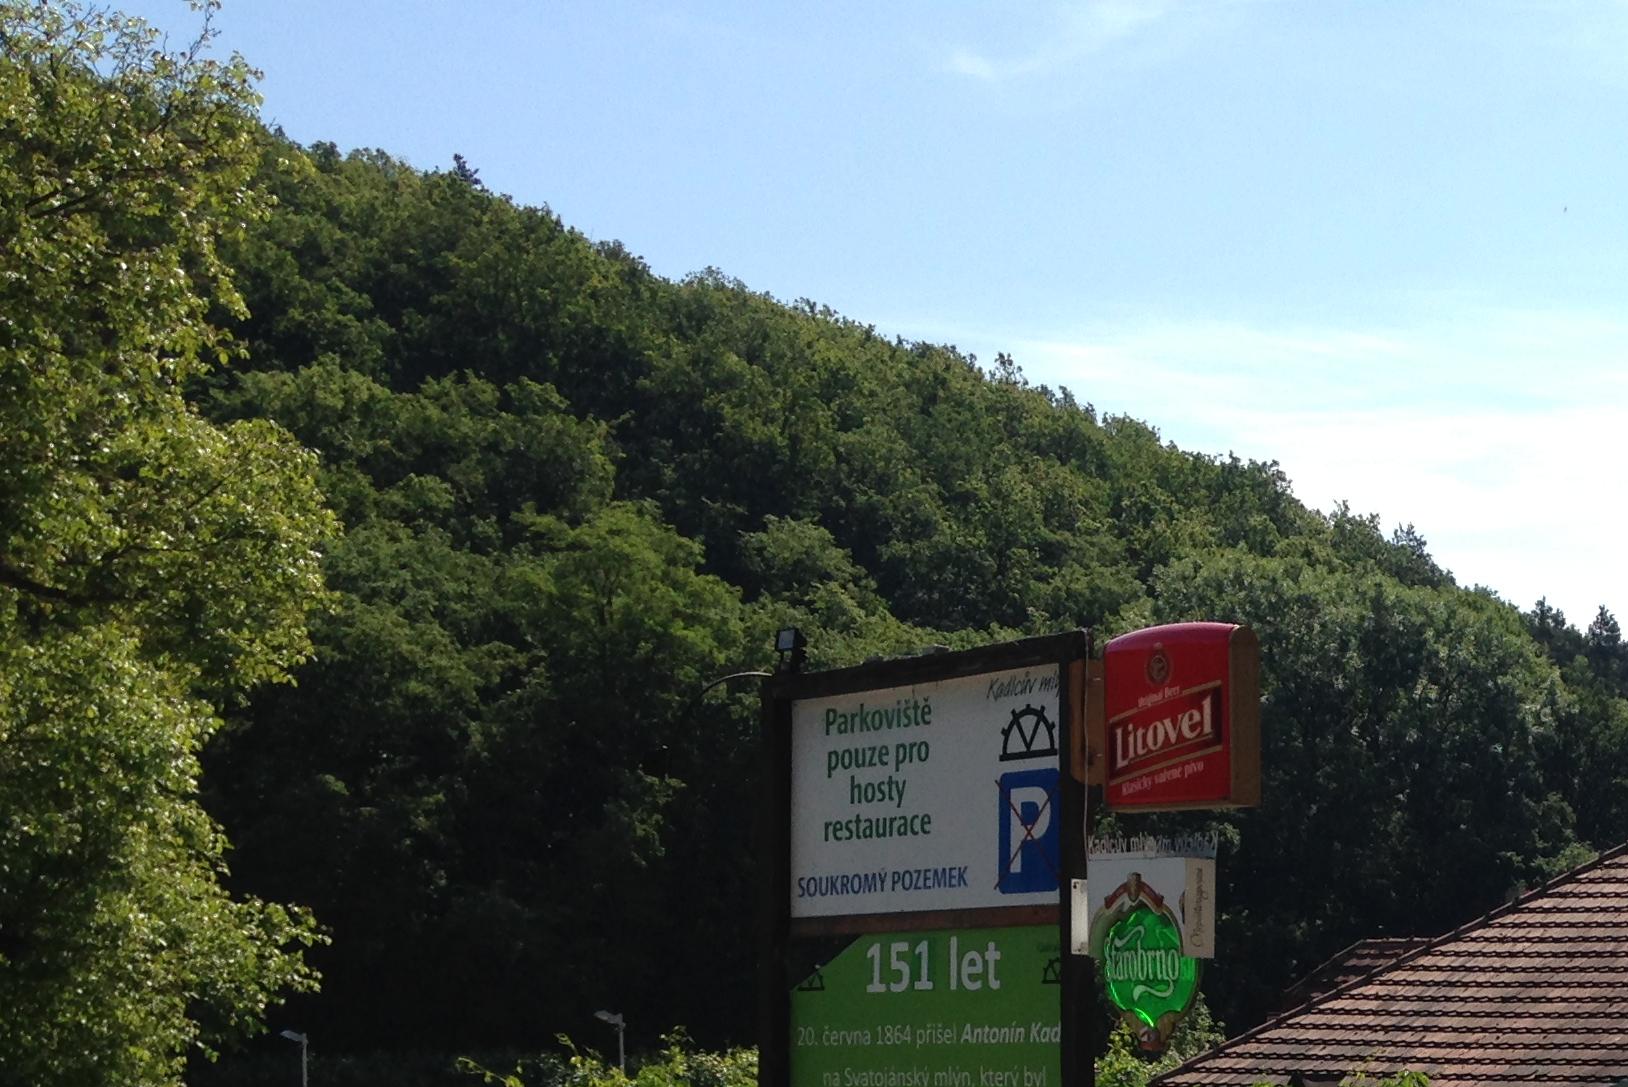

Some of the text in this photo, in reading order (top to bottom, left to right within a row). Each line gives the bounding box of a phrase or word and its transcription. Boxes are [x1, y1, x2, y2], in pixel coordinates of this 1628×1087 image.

[825, 696, 932, 736] Parkoviště
[1115, 694, 1213, 770] Litovel
[827, 740, 930, 778] pouze pro
[850, 775, 906, 808] hosty
[824, 812, 932, 842] restaurace
[798, 866, 969, 898] SOUKROMÝ POZEMEK
[866, 935, 1002, 993] 151 let
[1104, 938, 1180, 982] Starobrno
[797, 1025, 818, 1047] 20.
[823, 1025, 872, 1047] června
[876, 1024, 912, 1045] 1864
[916, 1023, 957, 1049] přišel
[960, 1021, 1026, 1045] Antonín
[823, 1070, 841, 1087] na
